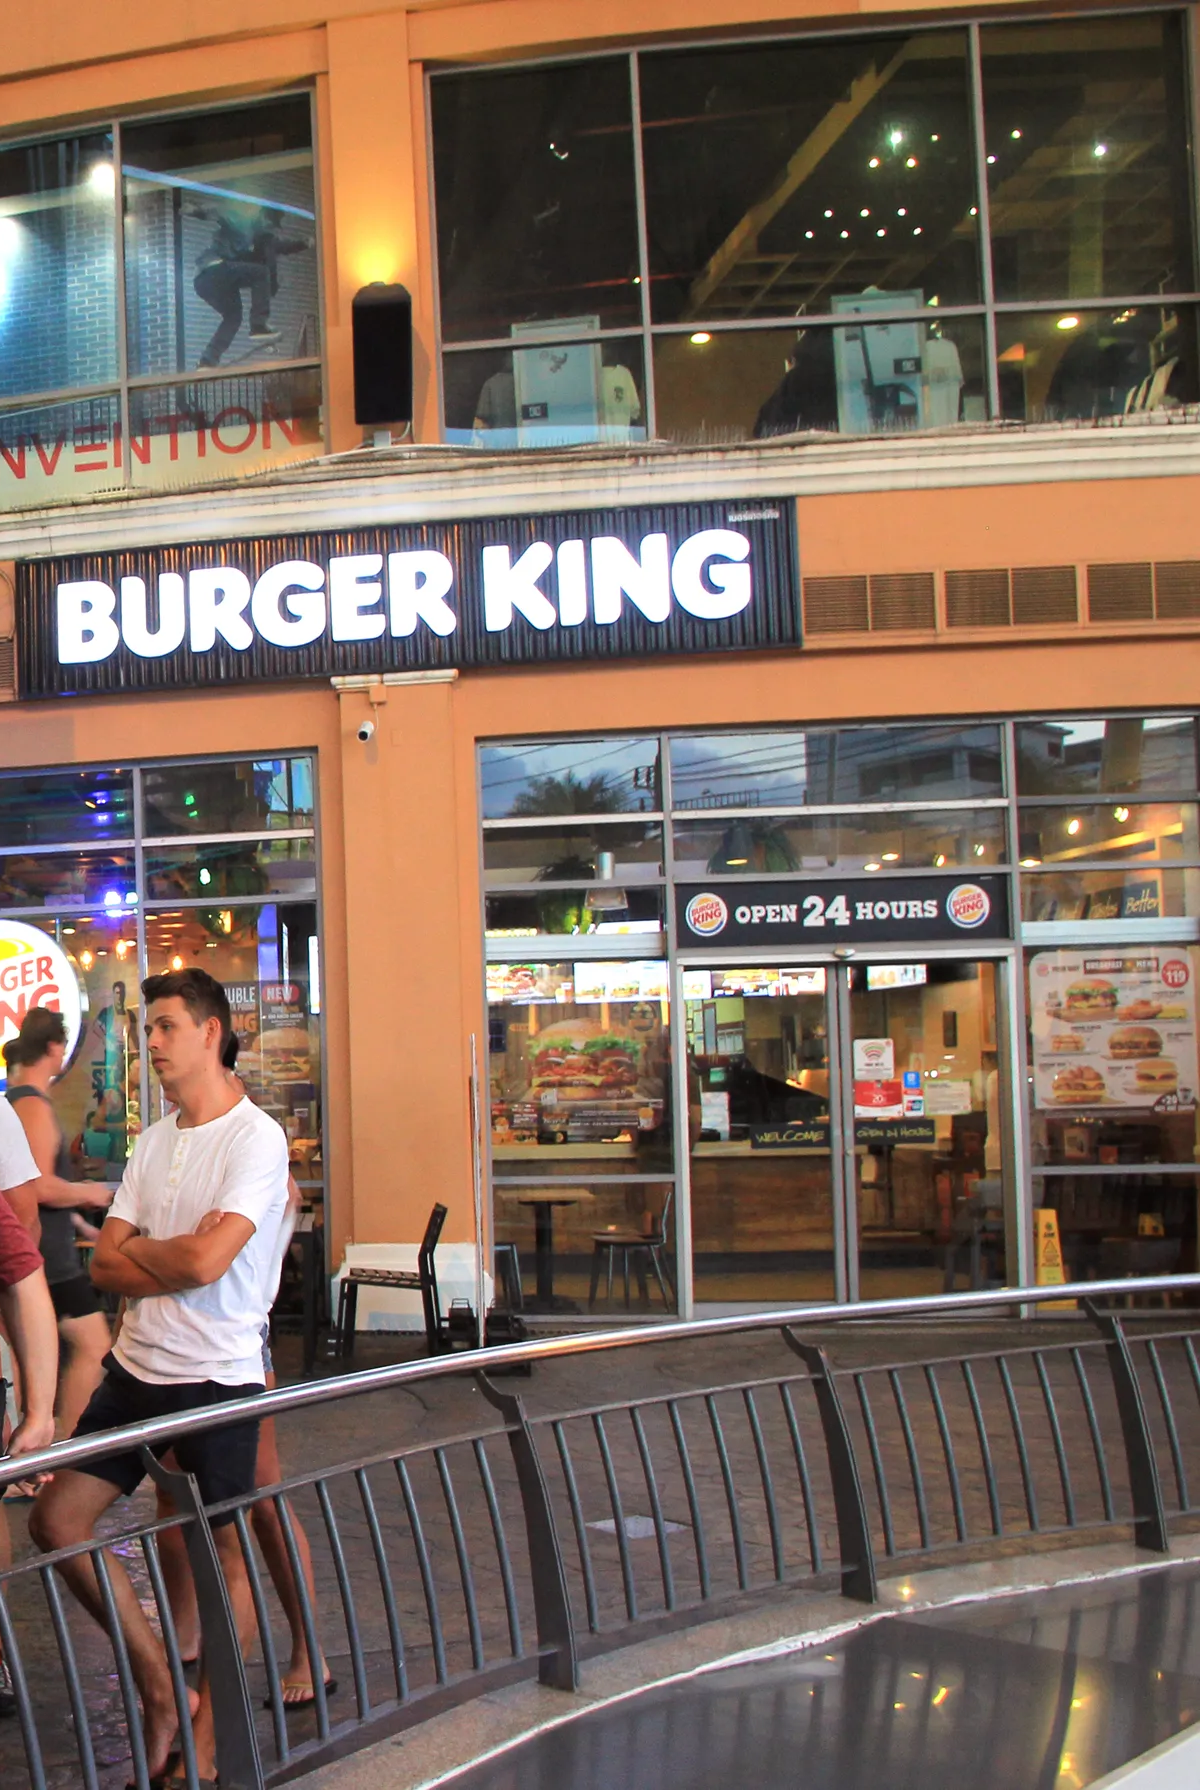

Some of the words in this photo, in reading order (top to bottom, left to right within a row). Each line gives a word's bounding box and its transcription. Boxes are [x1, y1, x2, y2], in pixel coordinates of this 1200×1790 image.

[56, 548, 457, 665] BURGER
[481, 527, 752, 632] KING
[691, 900, 720, 917] BURGER
[951, 891, 983, 909] BURGER
[953, 898, 985, 918] KING
[692, 909, 722, 927] KING
[734, 904, 798, 925] OPEN
[802, 895, 851, 927] 24
[855, 900, 938, 921] HOURS
[266, 986, 293, 1002] NEW
[230, 1012, 258, 1033] NG
[755, 1129, 826, 1144] WELCOME
